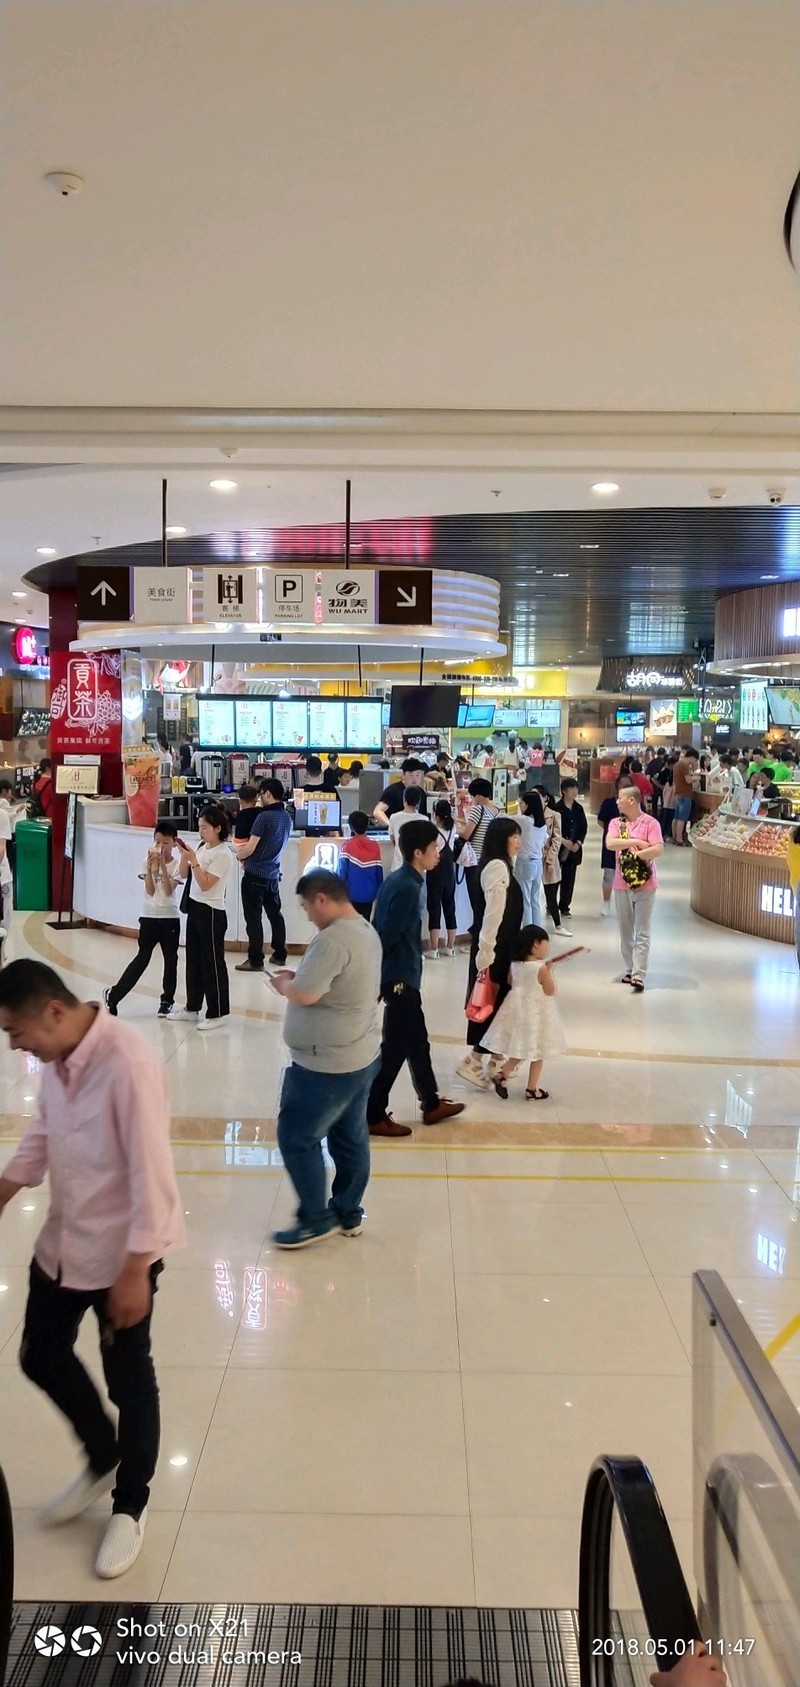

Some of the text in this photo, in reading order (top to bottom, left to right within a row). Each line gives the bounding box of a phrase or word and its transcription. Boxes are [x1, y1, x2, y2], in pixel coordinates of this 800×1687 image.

[147, 587, 176, 598] 美食街
[282, 579, 297, 598] P
[328, 598, 368, 608] 物美
[761, 884, 797, 917] HEL
